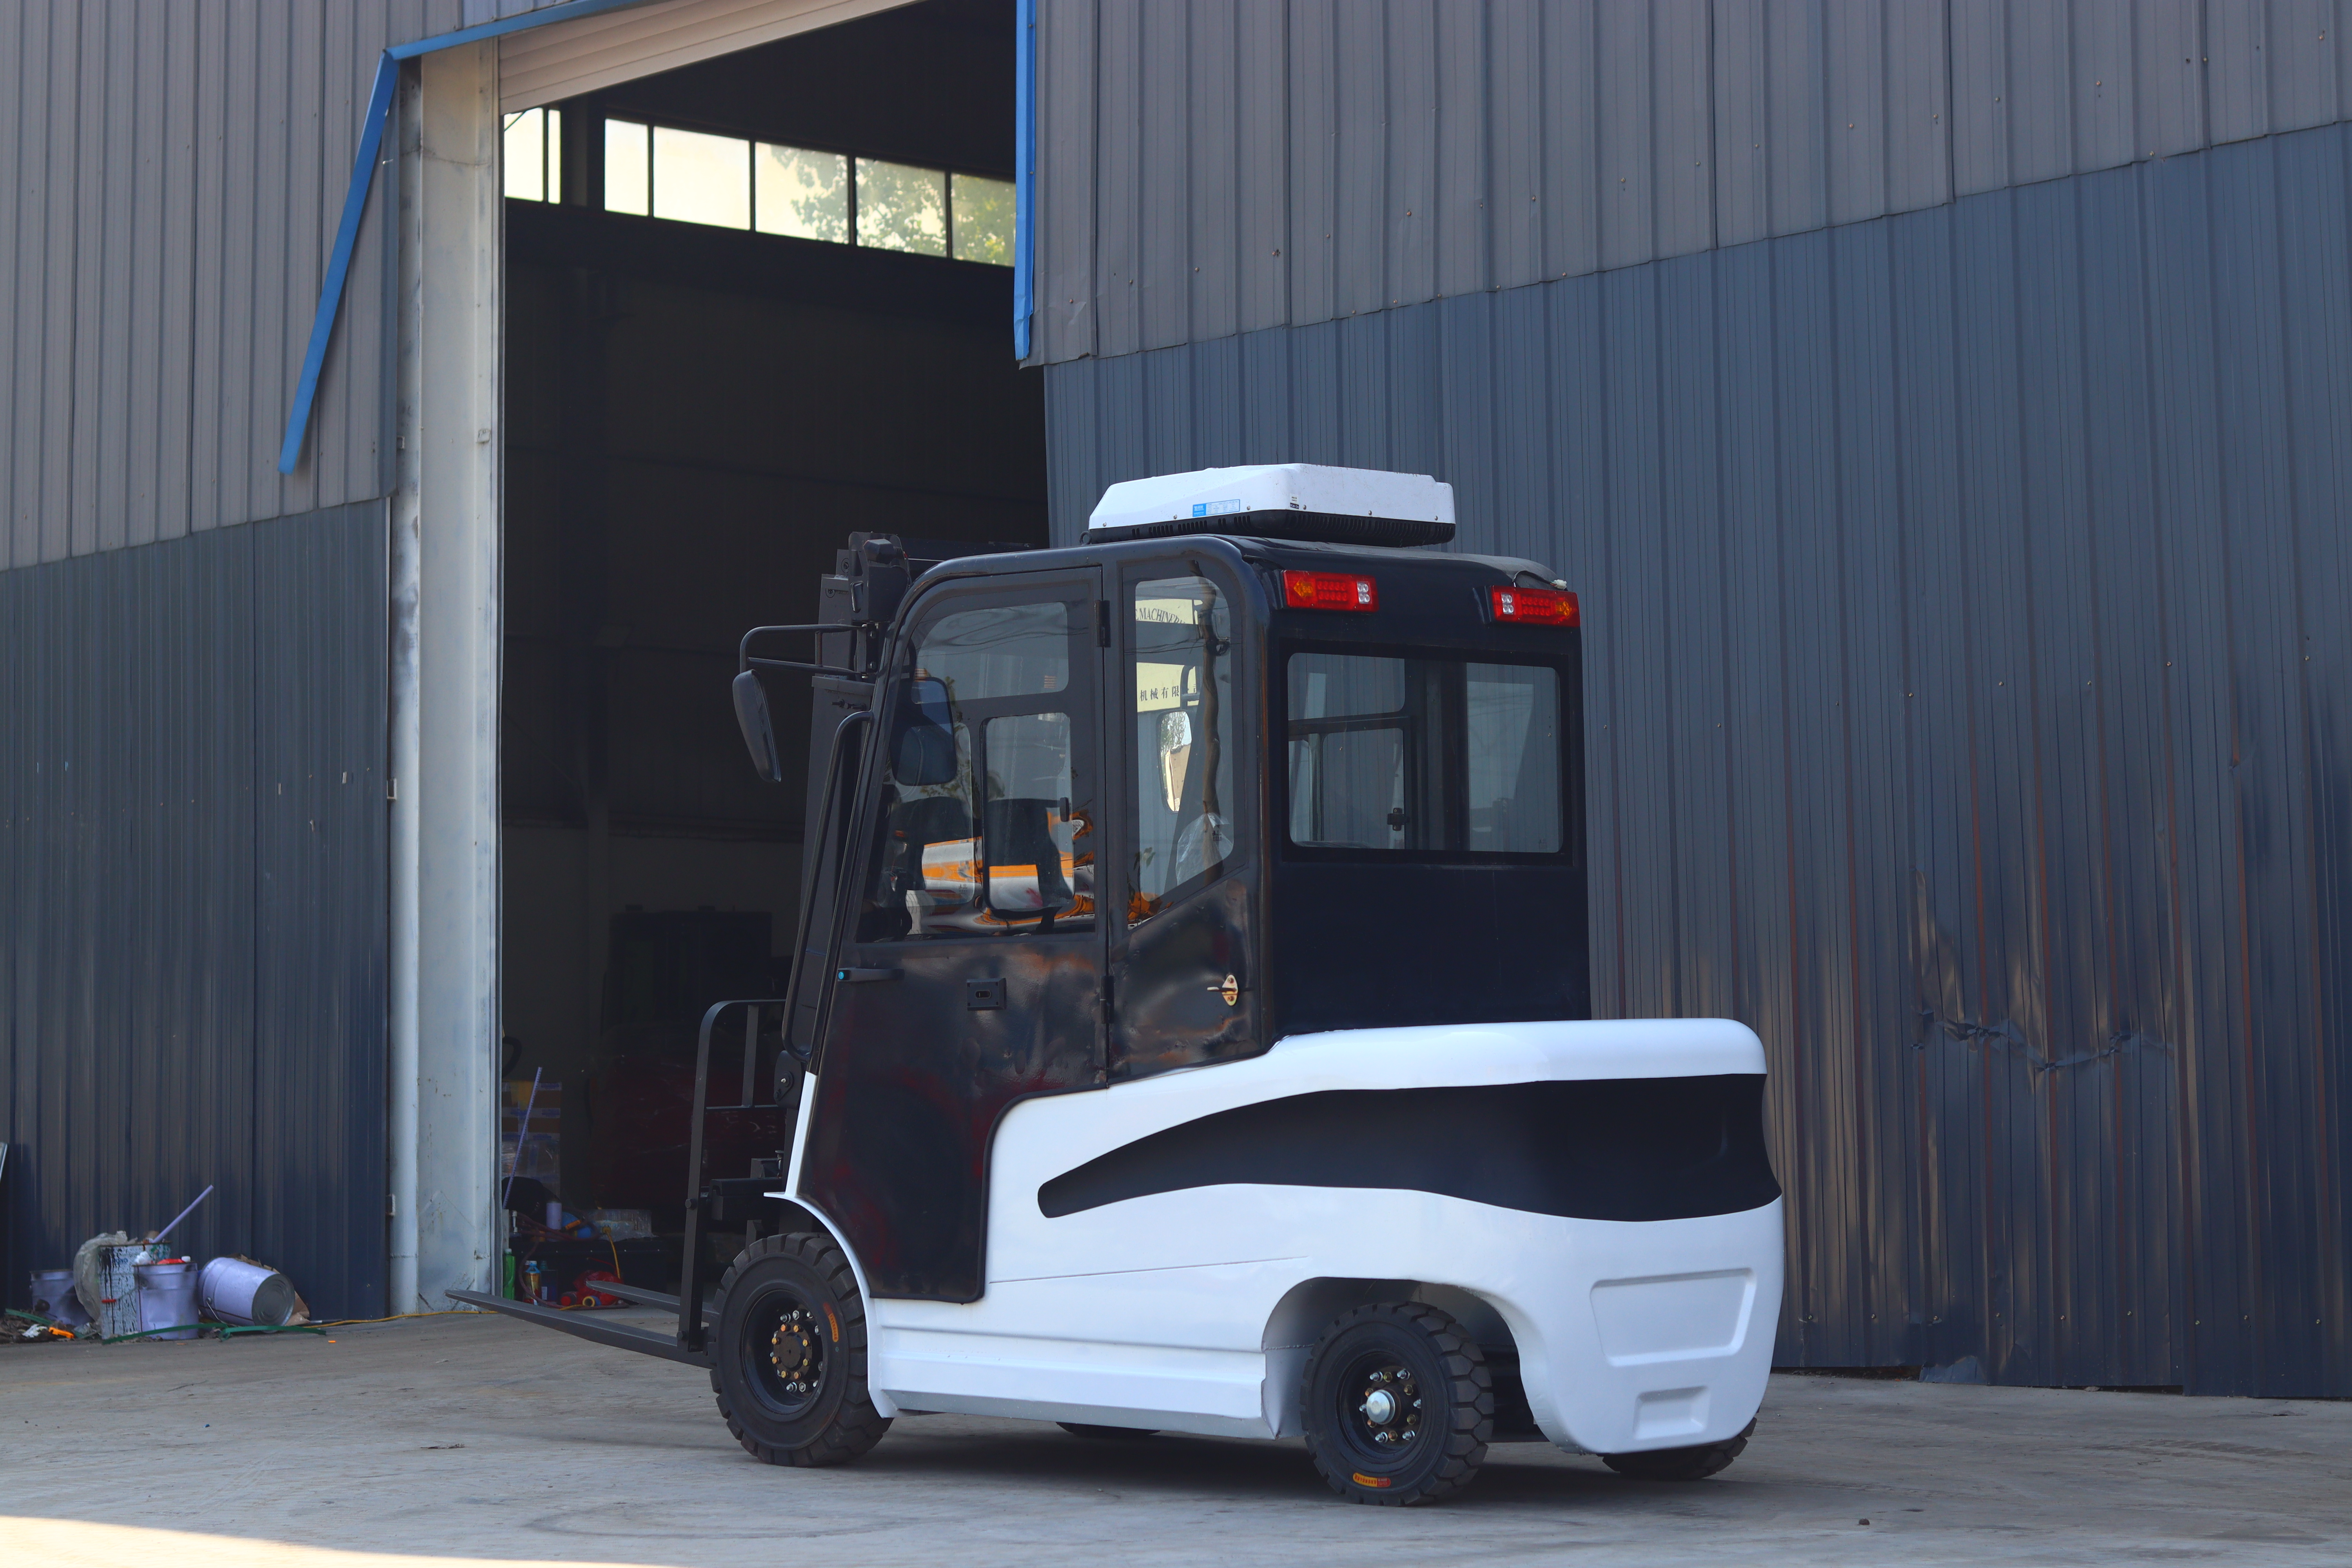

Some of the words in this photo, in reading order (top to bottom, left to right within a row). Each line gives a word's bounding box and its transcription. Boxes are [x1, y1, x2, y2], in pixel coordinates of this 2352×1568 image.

[1140, 607, 1185, 624] MACHINER
[1140, 684, 1196, 702] 机械有限
